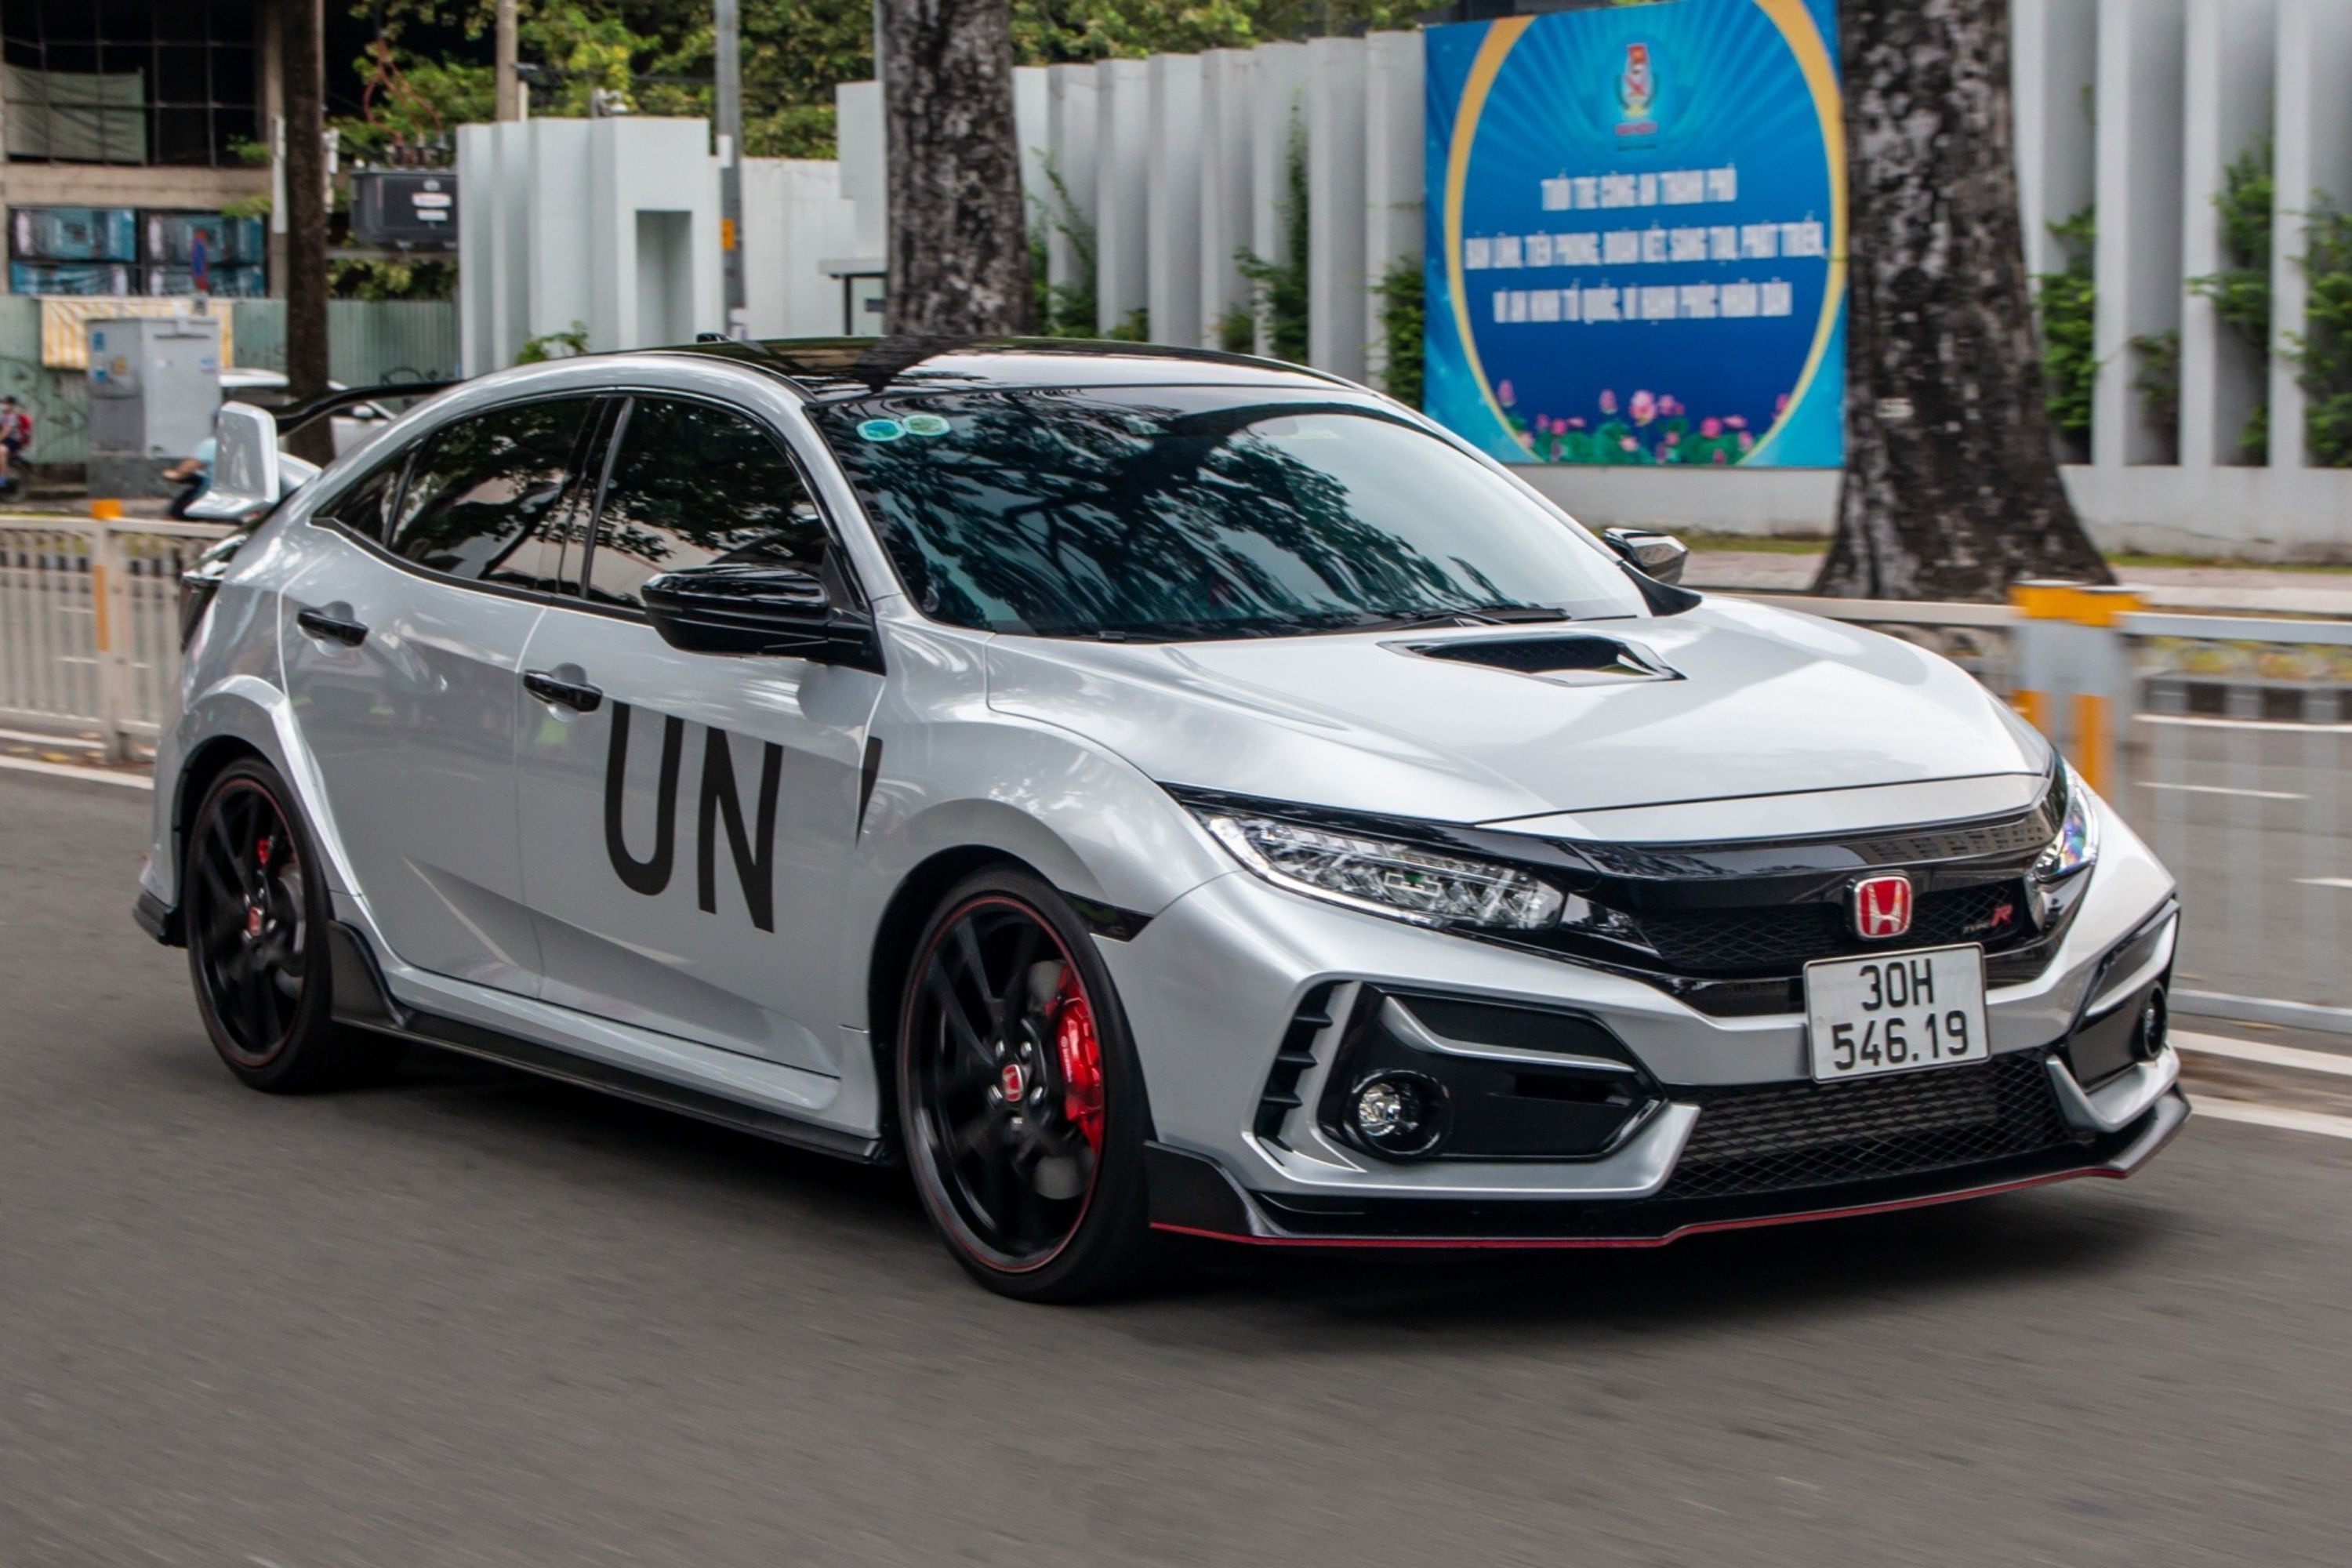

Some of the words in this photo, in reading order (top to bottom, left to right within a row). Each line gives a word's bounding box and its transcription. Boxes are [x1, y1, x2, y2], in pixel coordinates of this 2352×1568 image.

[604, 701, 783, 933] UN
[1859, 958, 1934, 1011] 30H
[1831, 1010, 1969, 1071] 546.19
